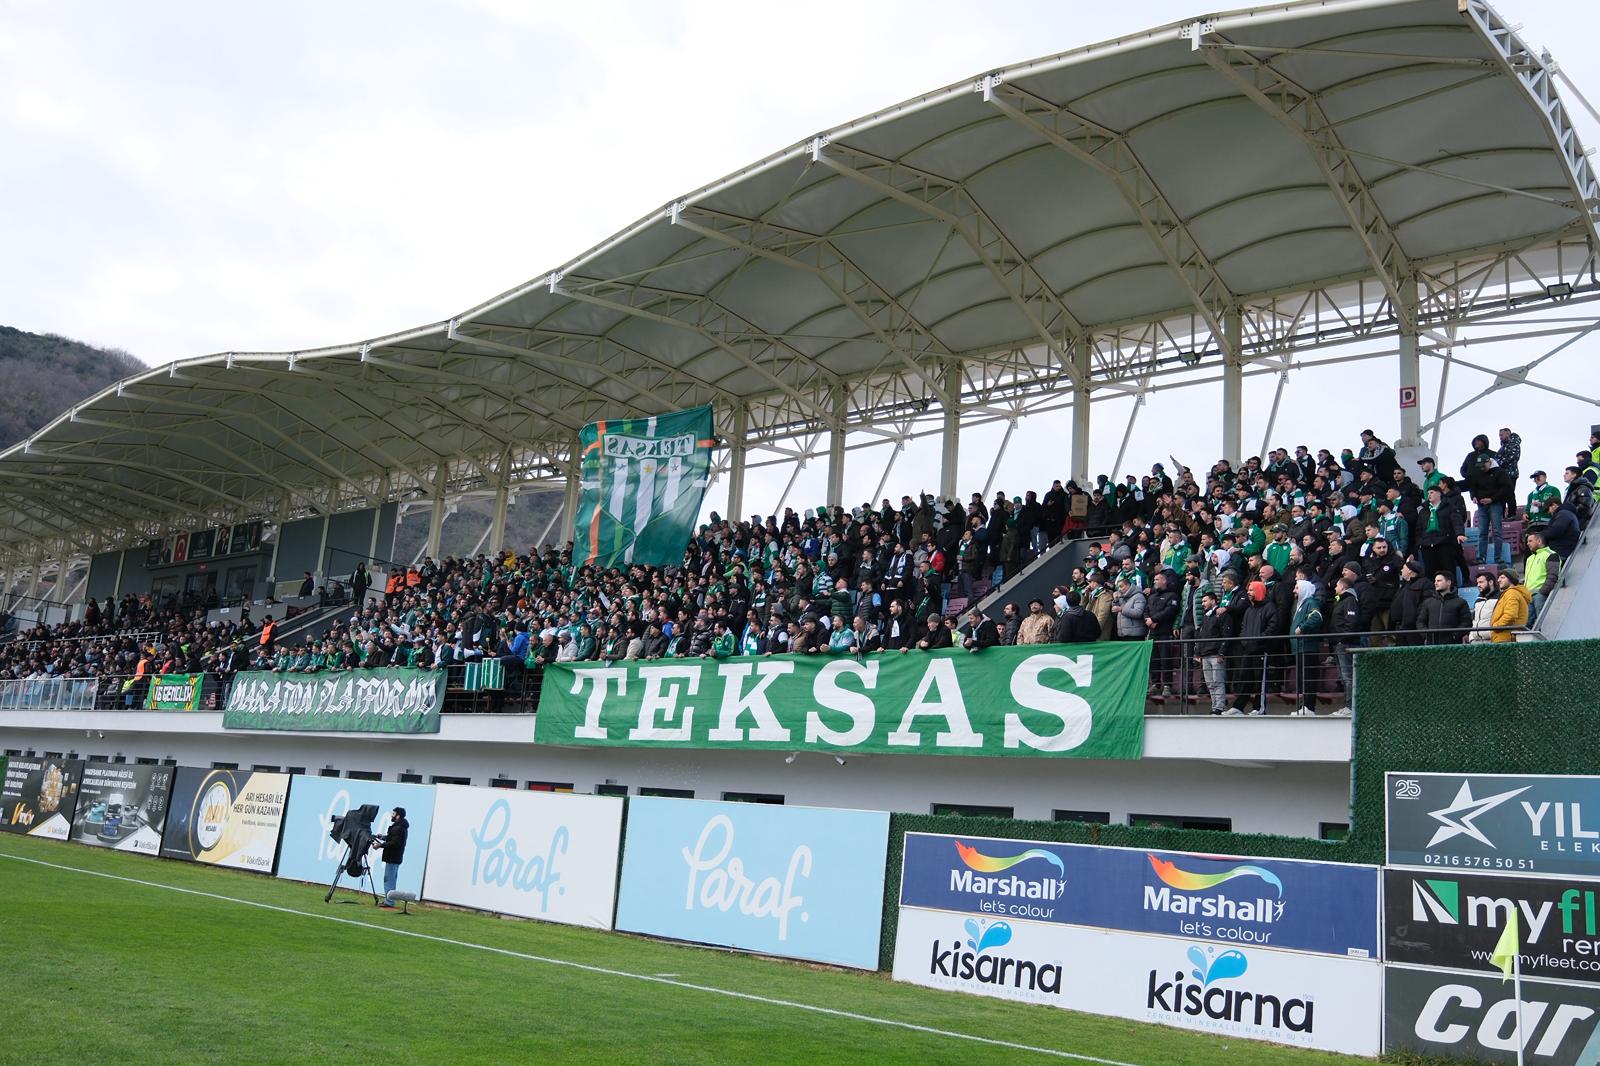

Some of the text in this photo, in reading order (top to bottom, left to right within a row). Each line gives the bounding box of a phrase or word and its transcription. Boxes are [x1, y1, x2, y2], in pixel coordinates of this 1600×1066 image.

[1402, 388, 1415, 404] D
[228, 677, 319, 716] MARATON
[570, 654, 1095, 753] TEKSAS
[255, 793, 275, 804] HESABI
[1395, 779, 1422, 797] 25
[233, 803, 245, 814] HER
[256, 805, 281, 817] KAZANIN
[1520, 801, 1600, 839] YIL
[1424, 854, 1534, 870] 0216 576 50 51
[950, 869, 1057, 901] Marshall
[979, 899, 1055, 919] let's colour
[1143, 885, 1273, 924] Marshall
[1179, 919, 1272, 944] let's colour
[930, 938, 1063, 995] kisarna
[1147, 969, 1314, 1034] kisarna
